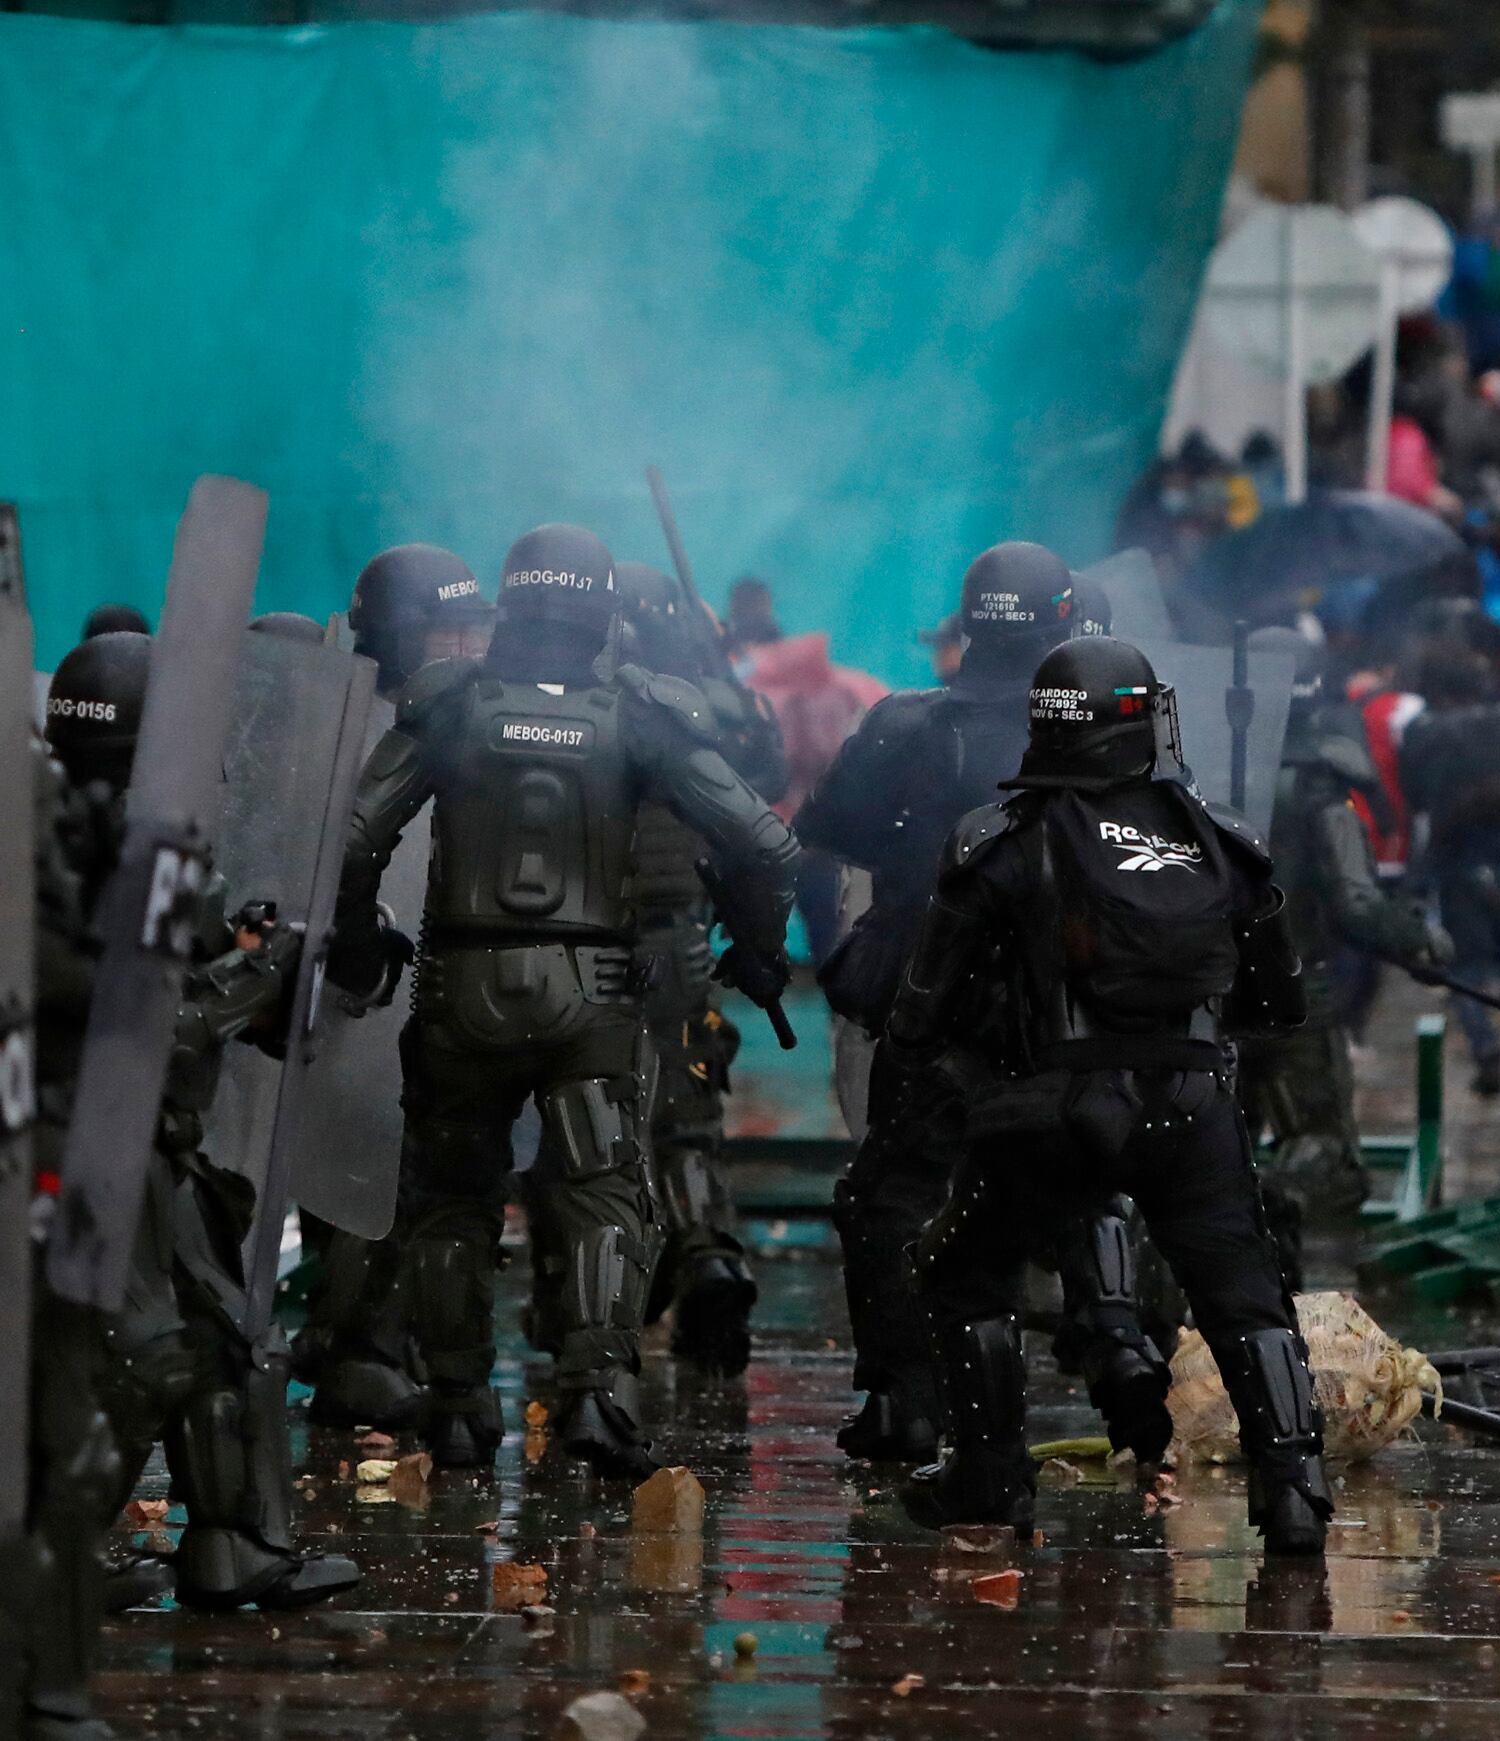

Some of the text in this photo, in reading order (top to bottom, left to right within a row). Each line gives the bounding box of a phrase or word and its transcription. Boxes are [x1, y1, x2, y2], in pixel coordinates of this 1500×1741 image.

[1005, 611, 1027, 621] SEC
[1028, 612, 1035, 621] 3
[1039, 698, 1078, 709] 172892
[1061, 710, 1084, 720] SEC
[1086, 711, 1093, 721] 3
[503, 724, 583, 746] MEBOG-0137
